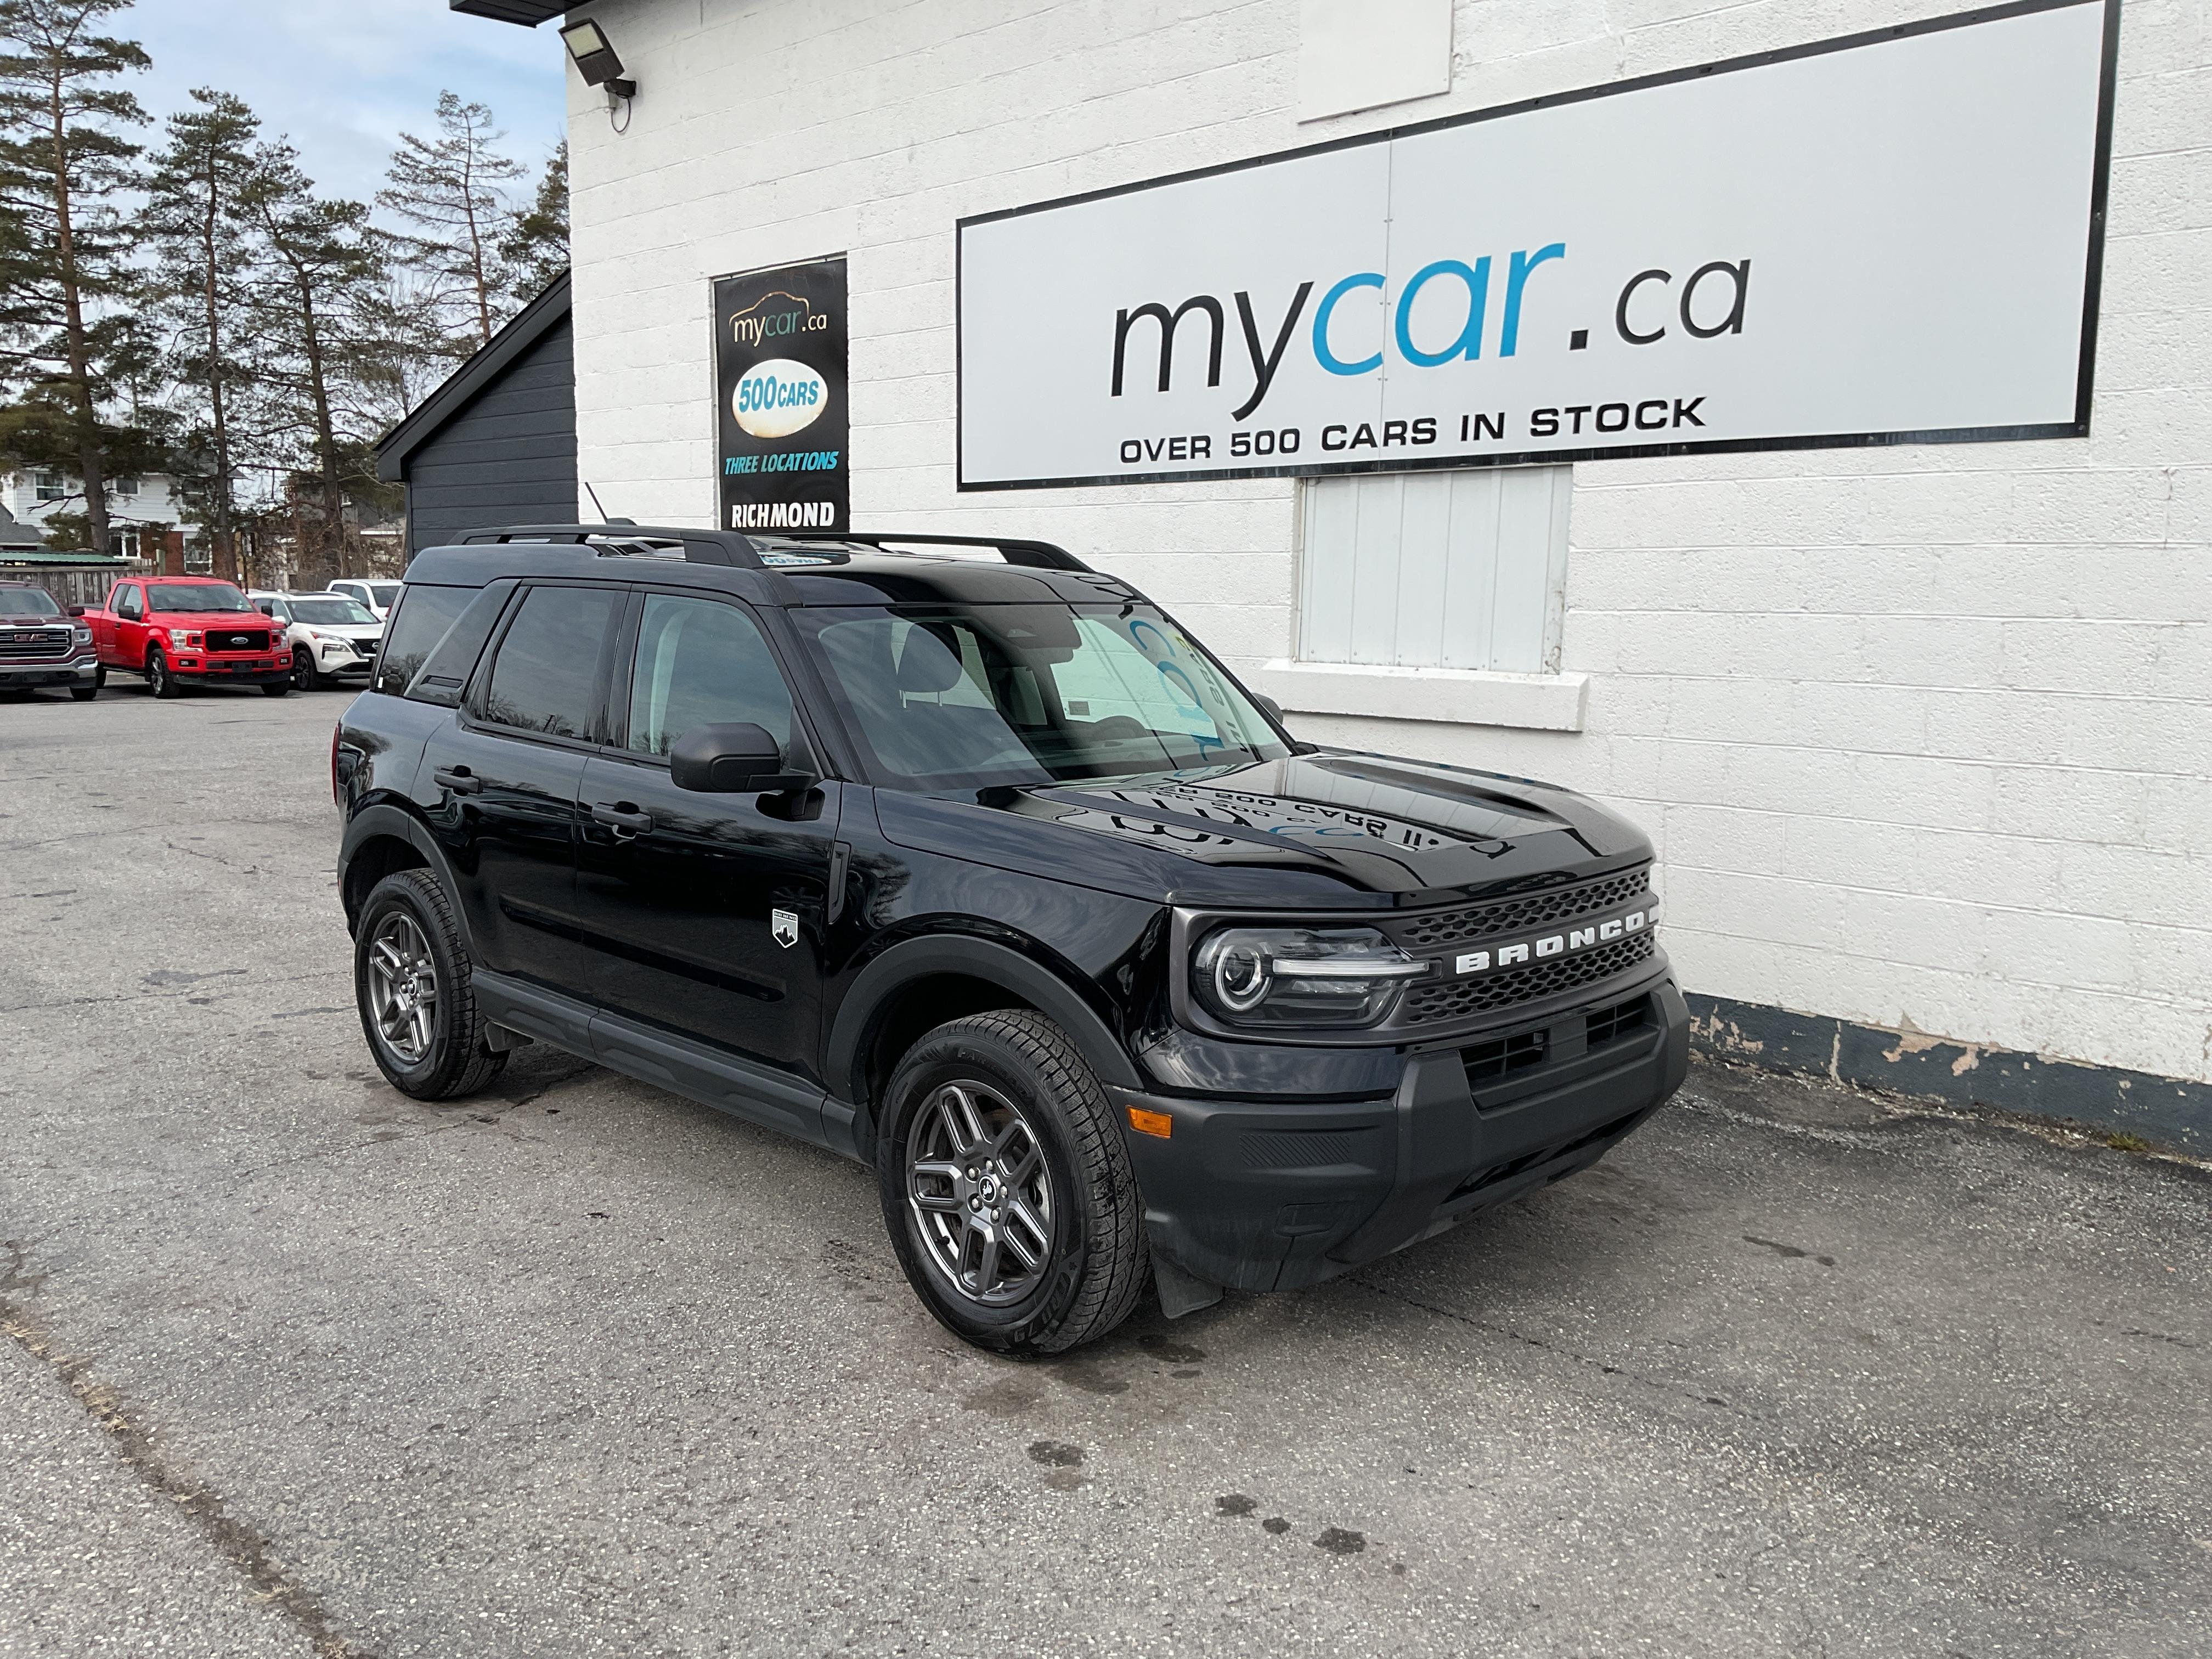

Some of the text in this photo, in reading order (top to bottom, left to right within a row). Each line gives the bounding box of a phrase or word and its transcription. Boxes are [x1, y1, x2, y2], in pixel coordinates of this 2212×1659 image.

[734, 311, 827, 347] mycar.ca
[1110, 242, 1752, 422] mycar.ca
[1120, 396, 1707, 464] OVER 500 CARS IN STOCK
[725, 450, 839, 475] THREE LOCATIONS
[731, 502, 834, 528] RICHMOND
[14, 634, 48, 642] GMC
[1455, 911, 1645, 974] BRONCO
